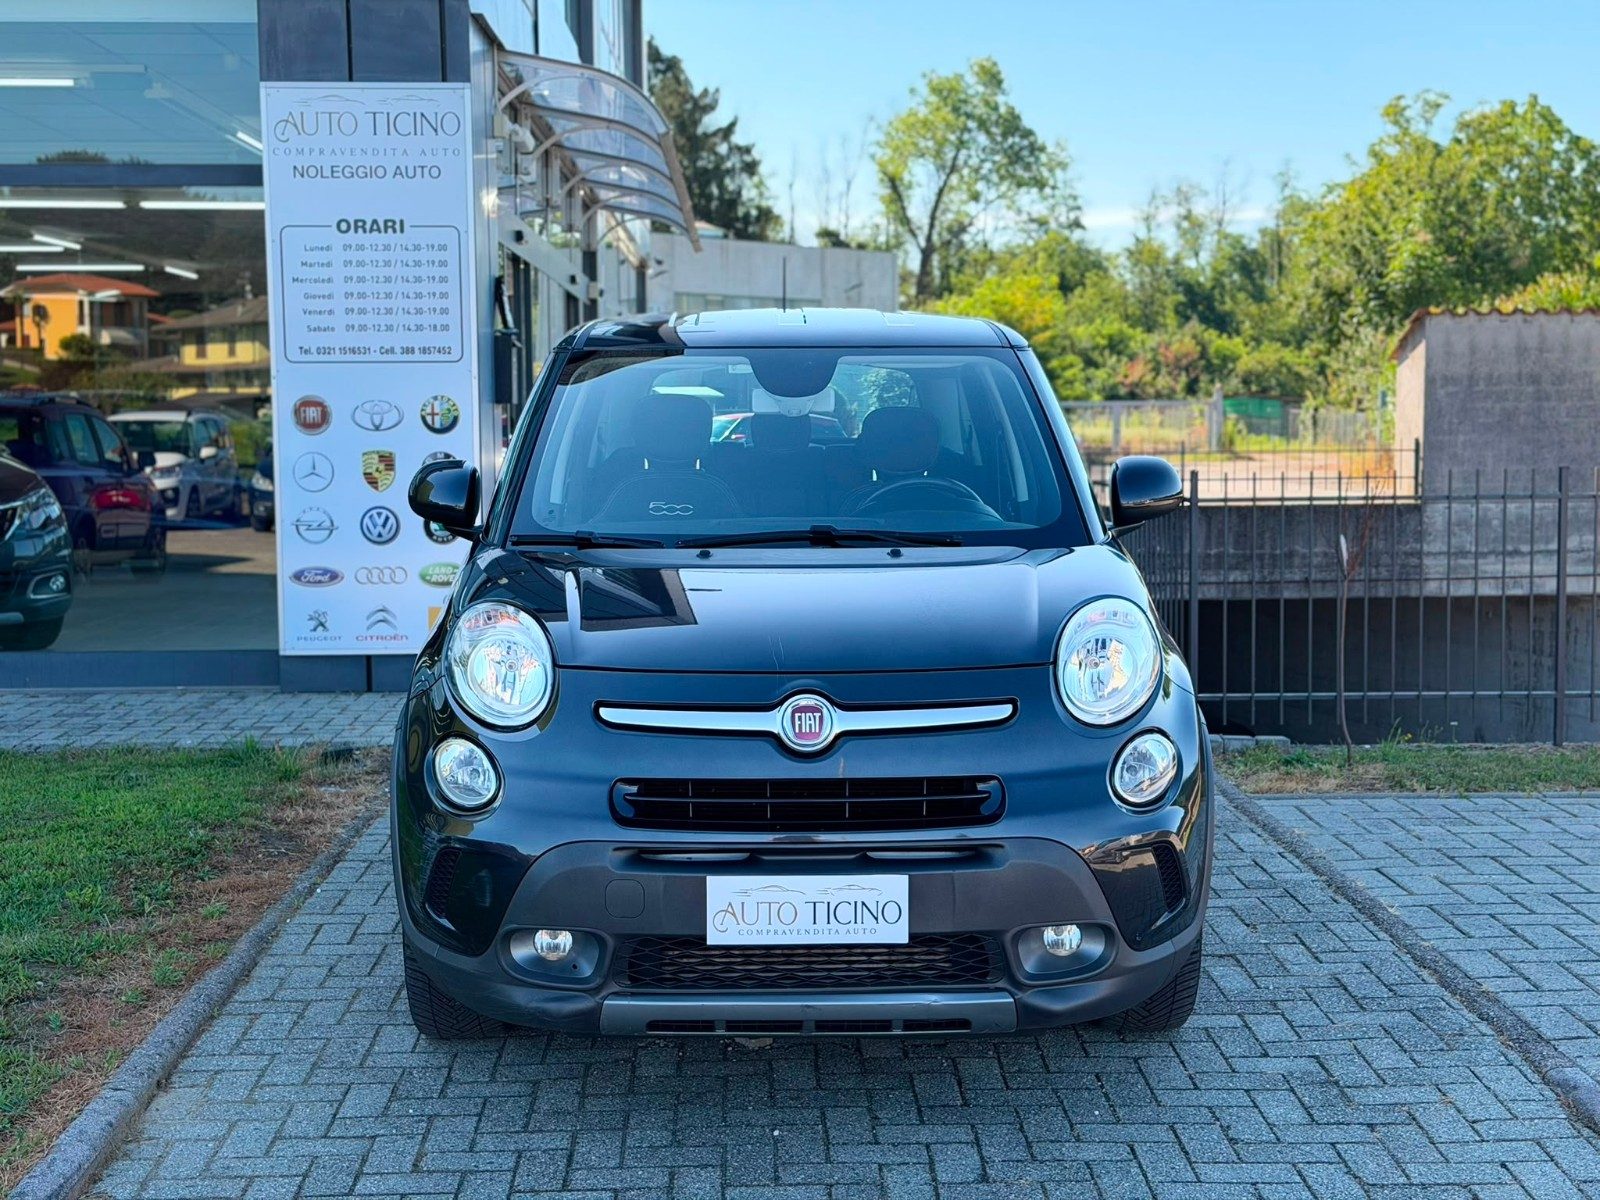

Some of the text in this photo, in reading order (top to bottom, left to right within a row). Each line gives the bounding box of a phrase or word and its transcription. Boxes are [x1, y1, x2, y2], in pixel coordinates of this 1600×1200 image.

[274, 111, 461, 143] AUTO TICINO
[273, 147, 461, 157] COMPRAVENDITA AUTO
[293, 165, 442, 179] NOLEGGIO AUTO
[336, 218, 405, 234] ORARI
[342, 243, 392, 252] 09.00-12.30
[400, 243, 448, 252] 14.30-19.00
[343, 259, 392, 268] 09.00-12.30
[401, 259, 448, 268] 14.30-19.00
[344, 275, 393, 284] 09.00-12.30
[401, 275, 449, 284] 14.30-19.00
[344, 291, 393, 300] 09.00-12.30
[401, 291, 449, 300] 14.30-19.00
[345, 307, 394, 316] 09.00-12.30
[402, 307, 450, 316] 14.30-19.00
[306, 324, 336, 332] Sabato
[345, 324, 394, 332] 09.00-12.30
[402, 323, 450, 332] 14.30-18.00
[298, 347, 314, 356] Tel.
[316, 346, 336, 356] 0321
[339, 346, 371, 355] 1516531
[379, 346, 397, 355] Cell.
[400, 346, 415, 355] 388
[418, 346, 452, 355] 1857452
[301, 407, 323, 423] FIAT
[649, 501, 694, 515] 500
[301, 569, 331, 582] Ford
[795, 712, 821, 733] FIAT
[712, 900, 902, 933] AUTO TICINO
